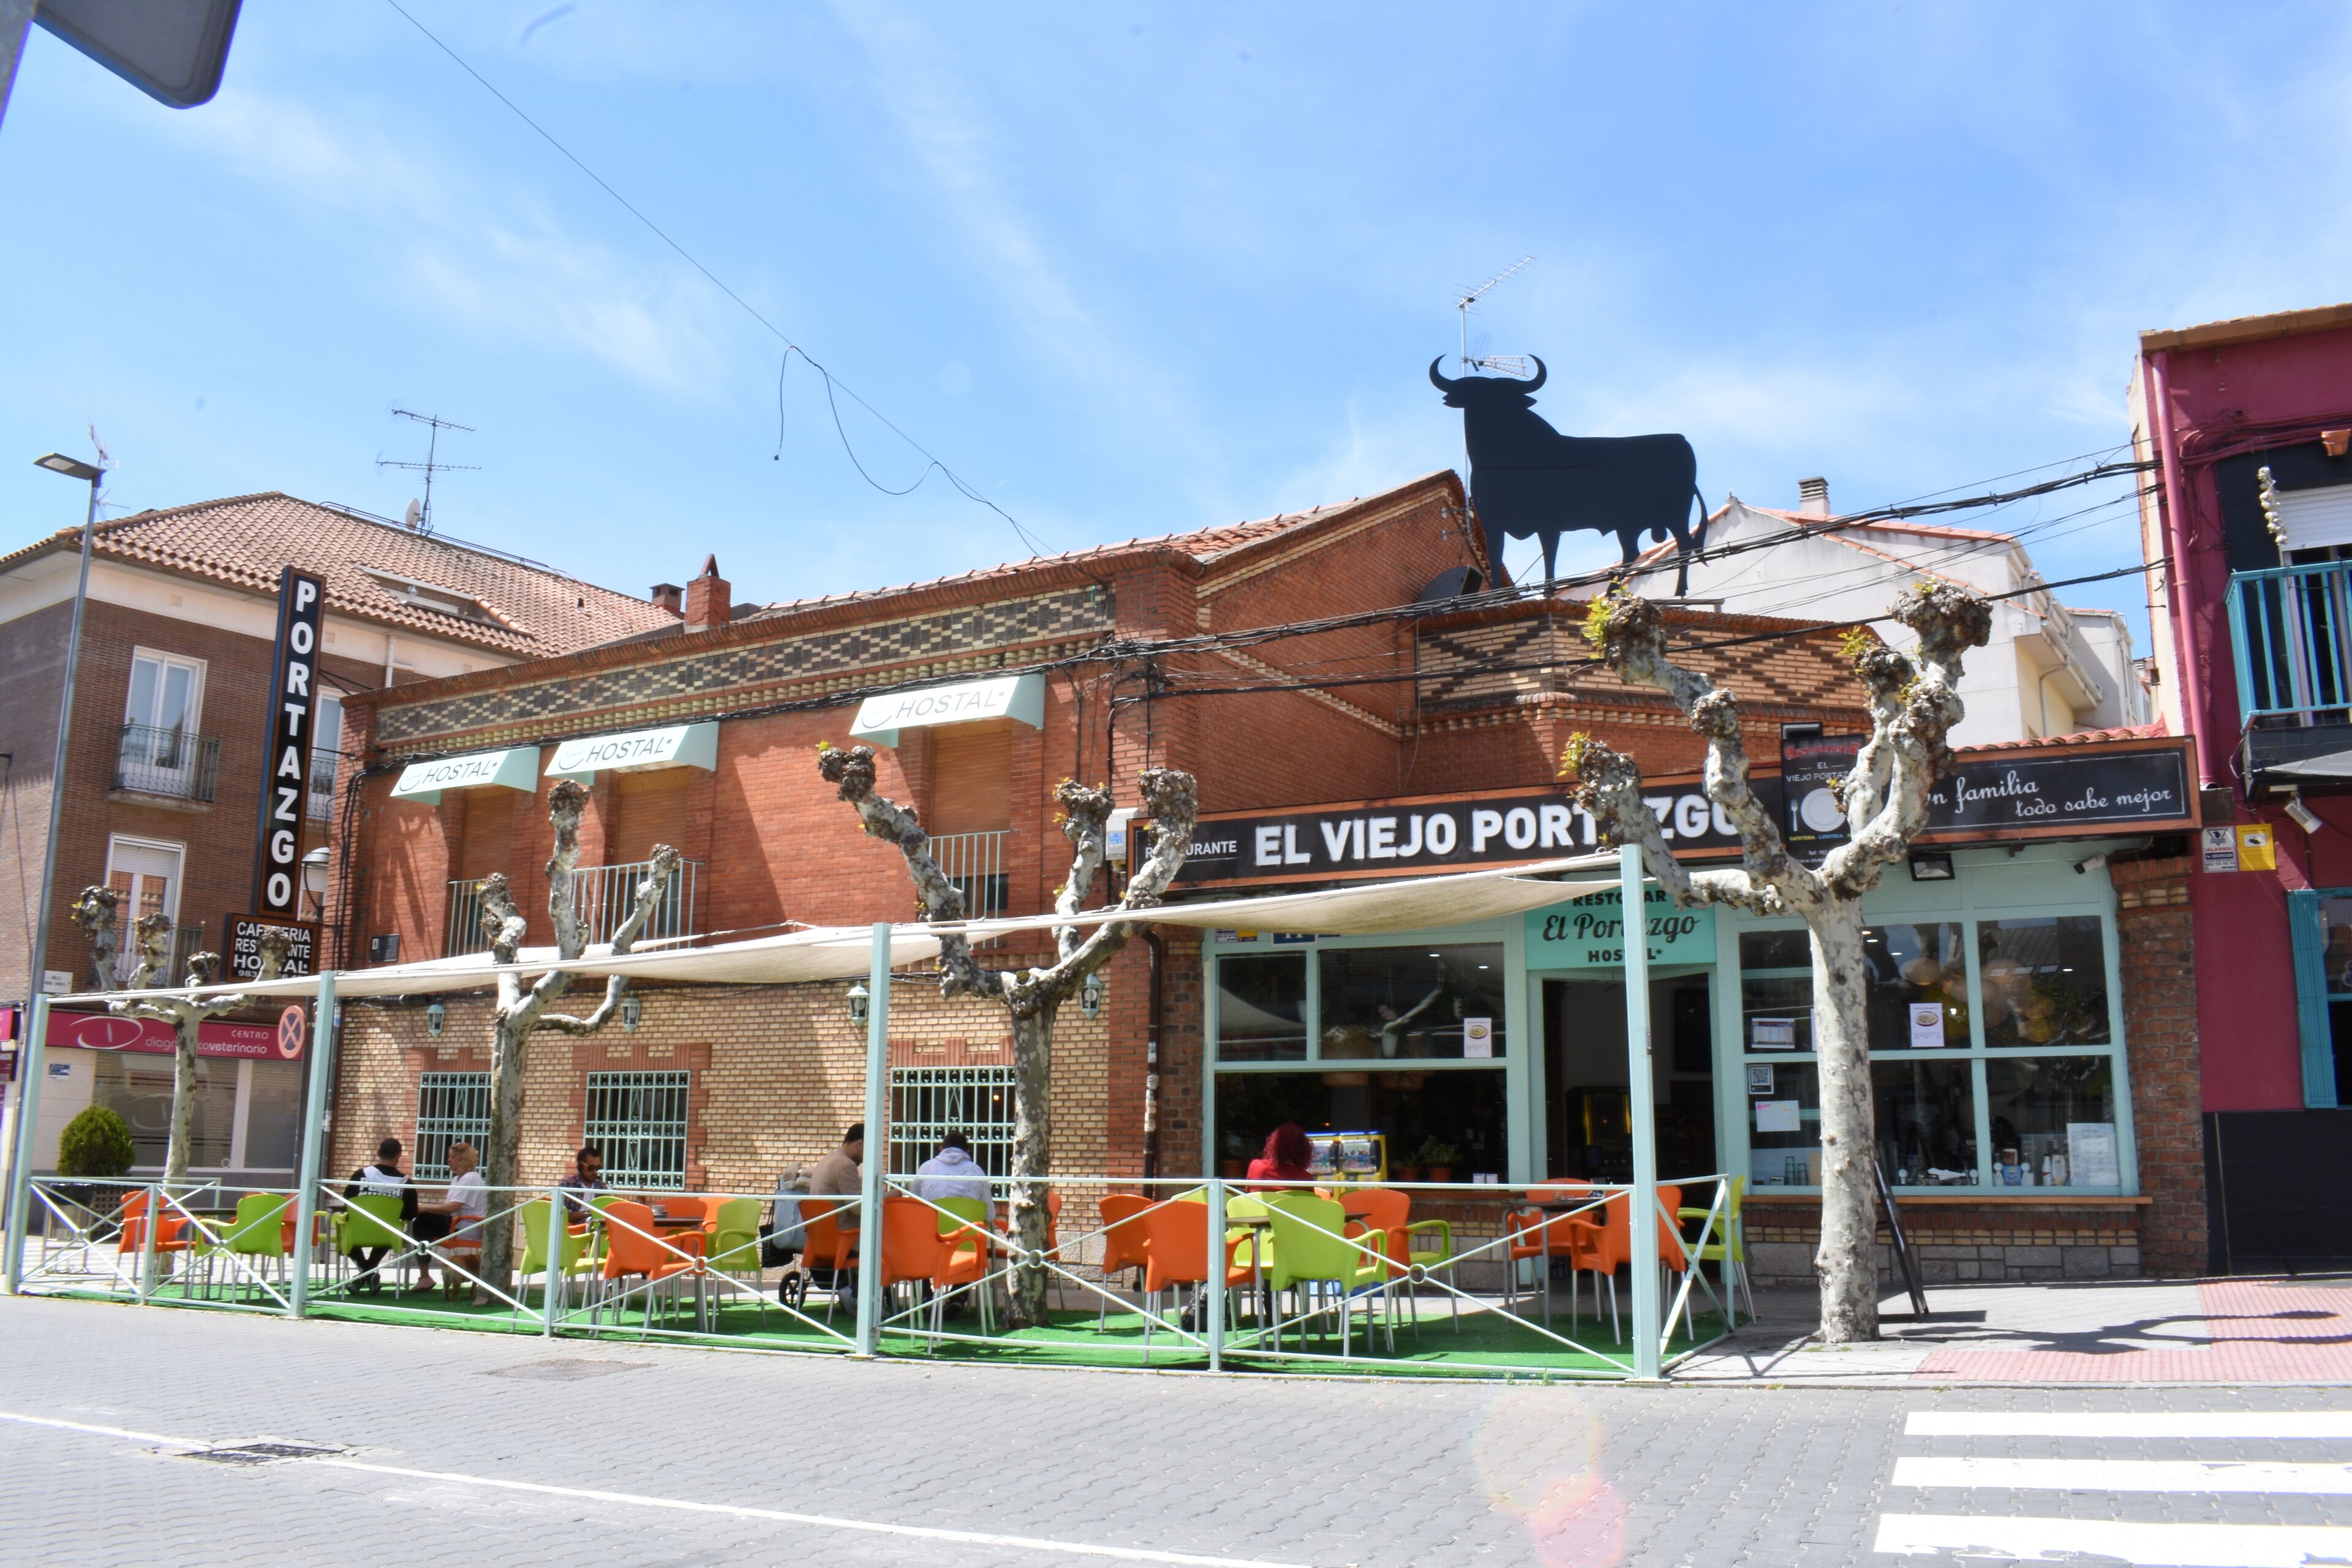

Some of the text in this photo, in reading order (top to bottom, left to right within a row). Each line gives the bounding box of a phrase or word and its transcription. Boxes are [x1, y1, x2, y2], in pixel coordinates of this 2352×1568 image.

[268, 580, 316, 907] PORTAZGO
[1786, 771, 1849, 782] VIEJO PORTAZ
[1928, 771, 2040, 813] n familia
[2015, 787, 2172, 817] todo sabe mejor
[1255, 824, 1311, 866] EL
[1320, 813, 1457, 861] VIEJO
[1472, 794, 1739, 853] PORTZGO
[1572, 890, 1667, 907] RESTOAR
[1542, 913, 1701, 943] El Porzgo
[233, 954, 309, 974] HOAL
[1588, 948, 1656, 962] HOSL
[232, 1030, 269, 1039] CENTRO
